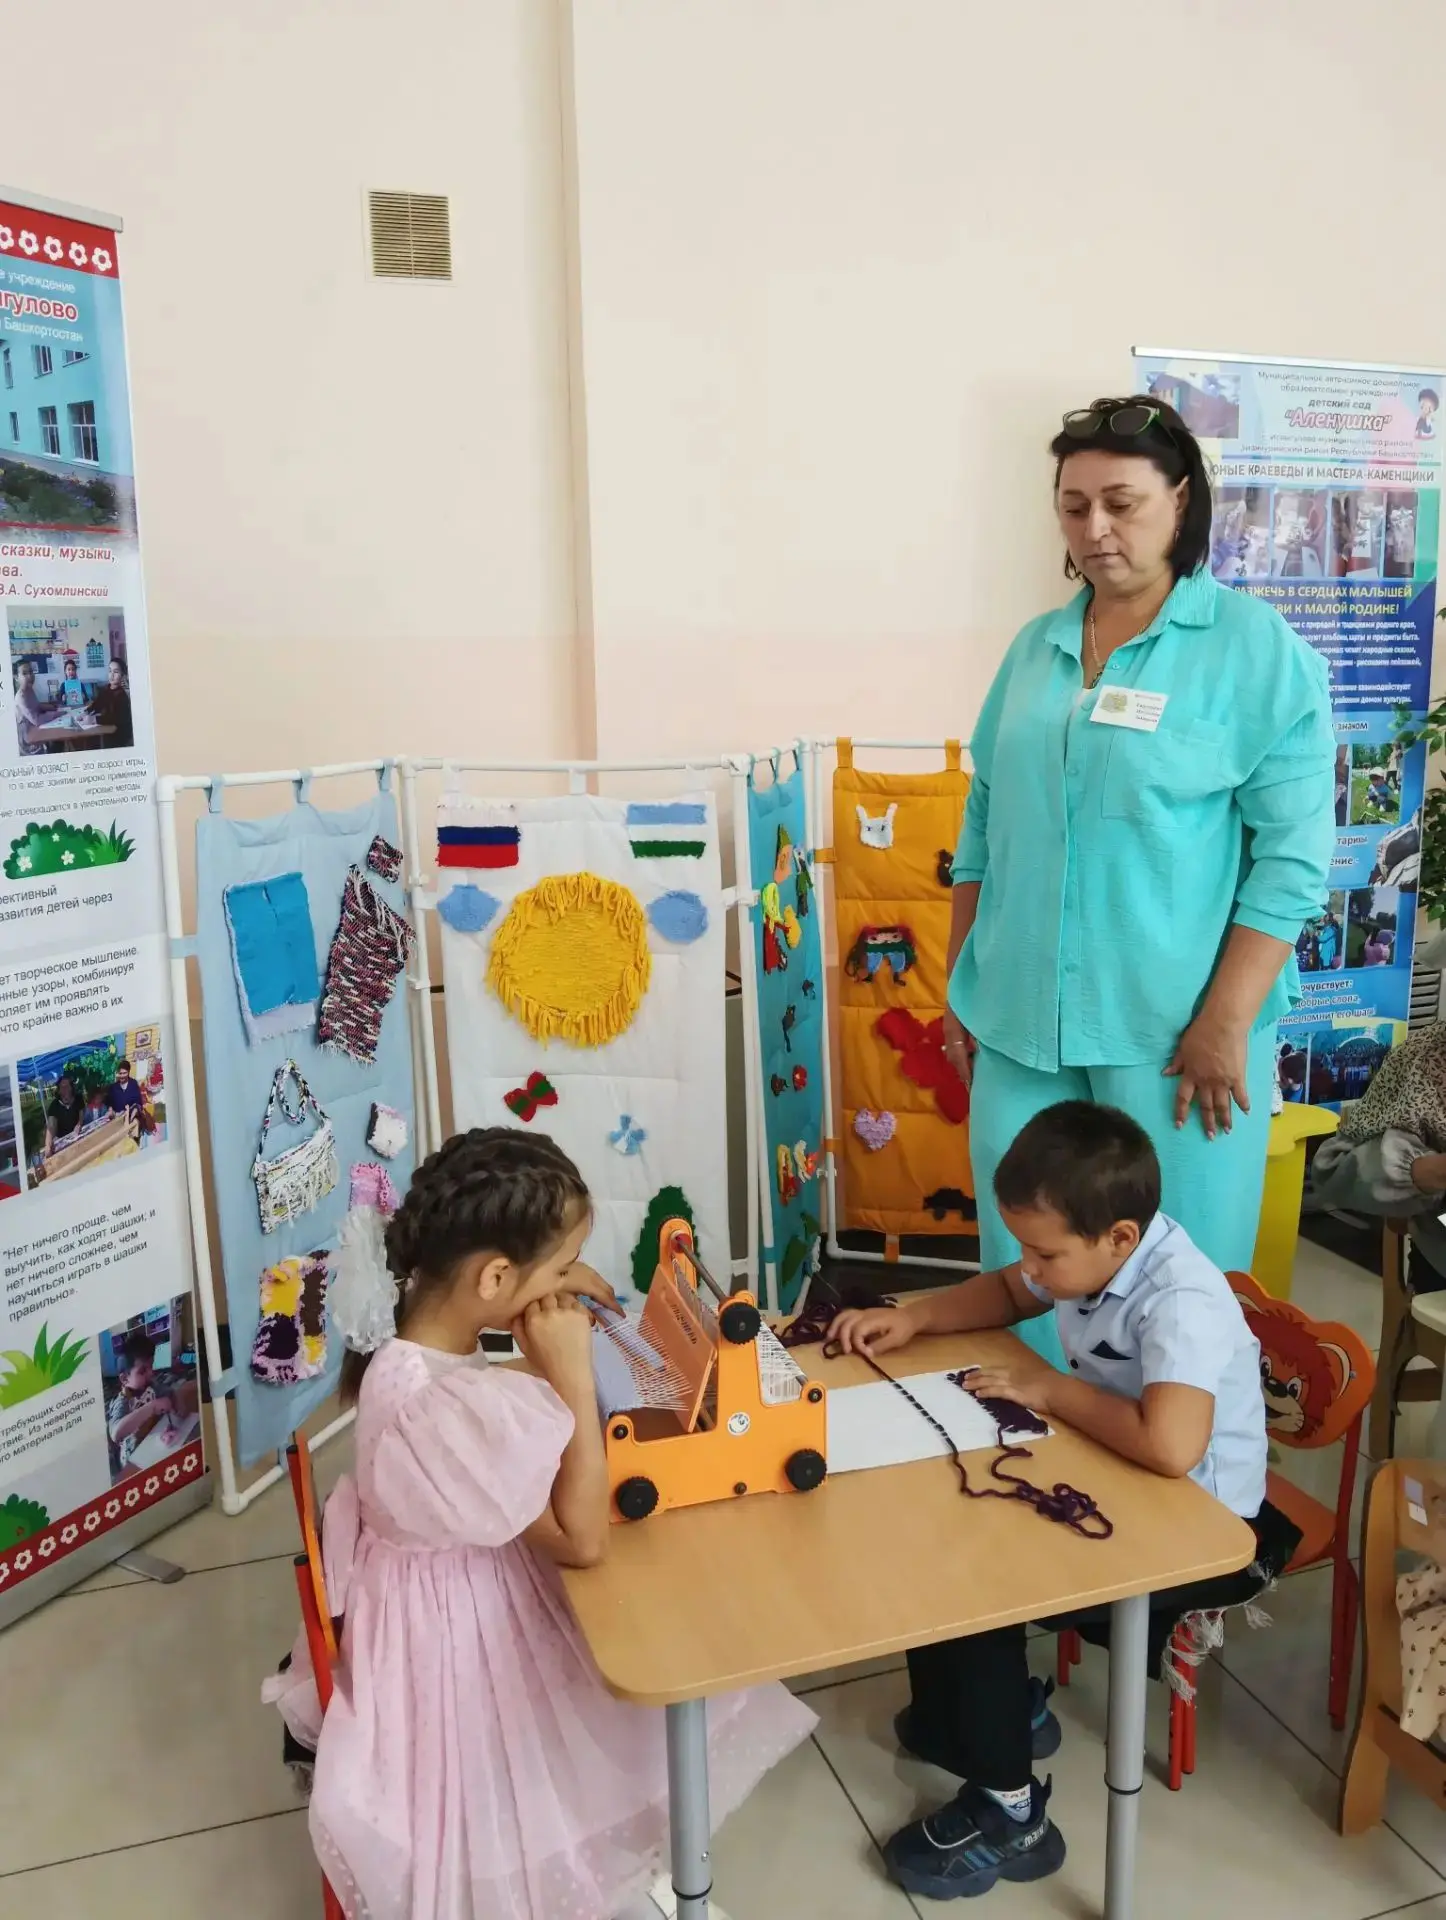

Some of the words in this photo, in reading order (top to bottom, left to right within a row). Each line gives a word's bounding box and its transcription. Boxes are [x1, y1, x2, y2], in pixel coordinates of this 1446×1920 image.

[8, 272, 76, 294] учреждение
[0, 290, 78, 322] гулово
[4, 317, 84, 342] Башкортостан
[1308, 398, 1350, 409] детский
[1352, 401, 1371, 411] сад
[1248, 465, 1304, 478] КРАЕВЕДЫ
[1307, 467, 1314, 477] И
[1, 545, 55, 560] сказки,
[59, 547, 115, 562] музыки,
[0, 566, 23, 577] ва.
[24, 584, 109, 598] Сухомлинский
[1289, 586, 1295, 597] В
[1298, 586, 1347, 600] СЕРДЦАХ
[1350, 585, 1412, 598] МАЛЫШЕЙ
[1295, 603, 1302, 614] К
[1305, 602, 1347, 615] МАЛОЙ
[1350, 603, 1400, 616] РОДИНЕ!
[0, 764, 35, 778] ОЛЬНЫЙ
[37, 762, 69, 775] ВОЗРАСТ
[47, 896, 79, 915] детей
[82, 891, 113, 907] через
[14, 959, 78, 982] творческое
[32, 978, 69, 998] узоры,
[72, 962, 135, 985] комбинируя
[35, 998, 50, 1010] им
[54, 985, 110, 1007] проявлять
[1, 1022, 19, 1034] что
[23, 1010, 62, 1030] крайне
[66, 1001, 99, 1018] важно
[102, 999, 108, 1009] в
[111, 995, 124, 1006] их
[32, 1229, 69, 1251] ничего
[112, 1203, 132, 1217] чем
[5, 1253, 55, 1278] выучить,
[58, 1242, 75, 1256] как
[78, 1227, 107, 1248] ходят
[150, 1208, 156, 1217] и
[6, 1277, 24, 1292] нет
[28, 1261, 66, 1284] ничего
[68, 1240, 117, 1266] сложнее,
[119, 1230, 139, 1244] чем
[8, 1276, 65, 1307] научиться
[67, 1261, 102, 1282] играть
[104, 1257, 110, 1266] в
[113, 1241, 148, 1263] шашки
[1, 1405, 54, 1438] требующих
[56, 1387, 89, 1410] особых
[28, 1424, 41, 1437] Из
[43, 1396, 96, 1430] невероятно
[0, 1452, 11, 1464] го
[13, 1426, 64, 1457] материала
[65, 1415, 82, 1431] для
